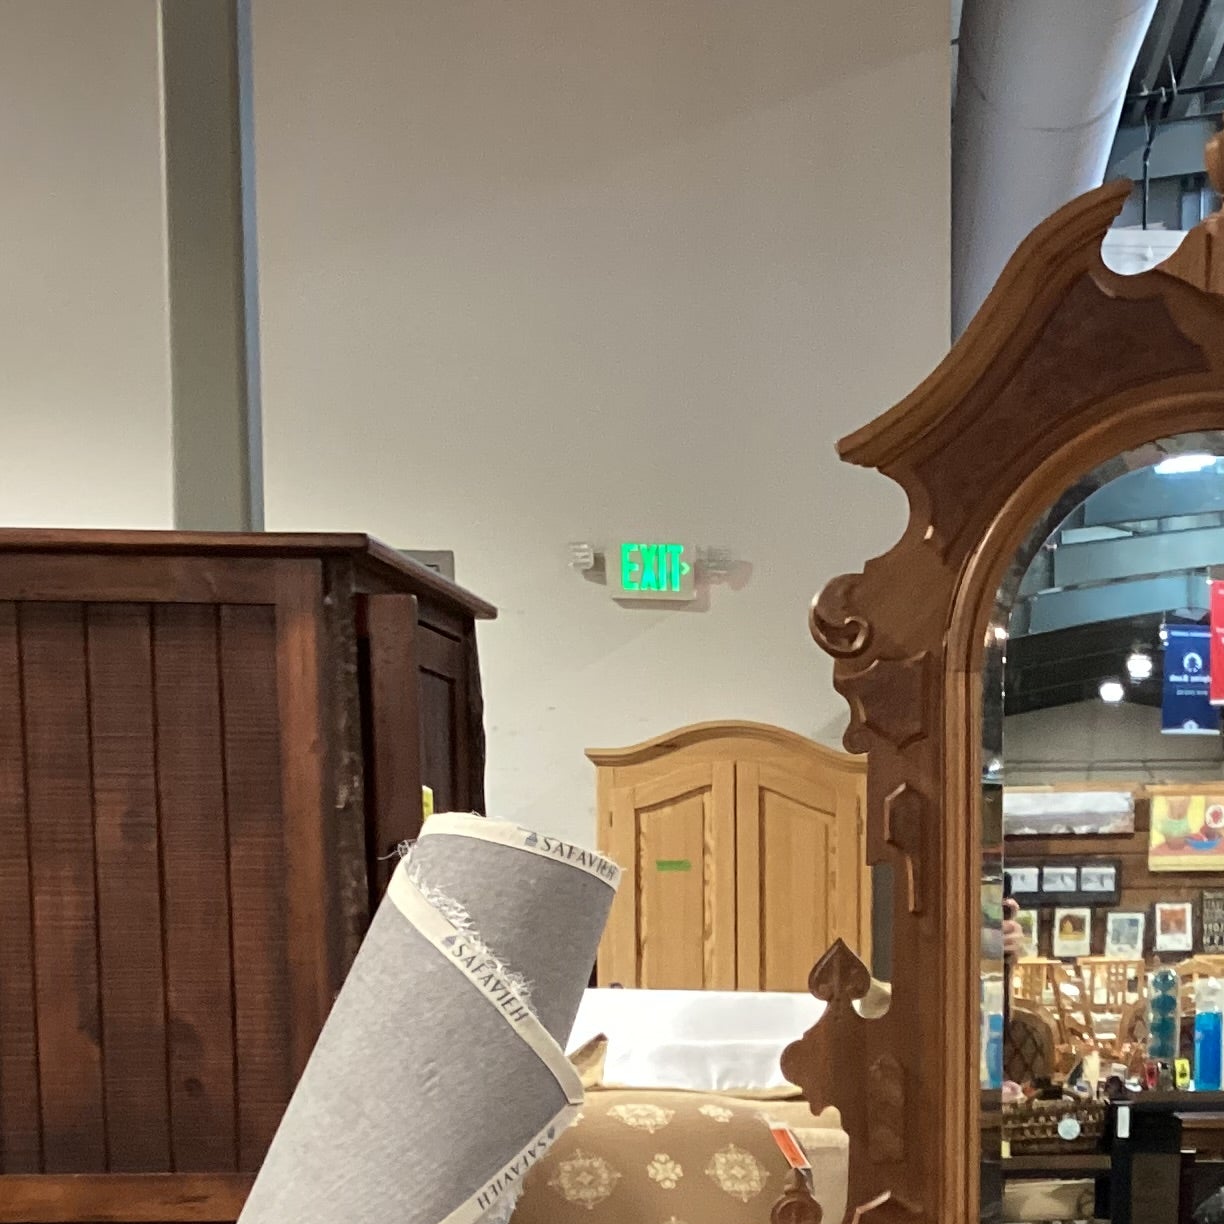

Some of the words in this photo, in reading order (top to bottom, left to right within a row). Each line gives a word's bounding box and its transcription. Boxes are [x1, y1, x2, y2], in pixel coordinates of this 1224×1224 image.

[621, 543, 684, 592] EXIT
[540, 837, 618, 881] SAFAVIEH
[452, 944, 529, 1022] SAFAVIEH
[477, 1138, 547, 1210] SAFAVIEH
